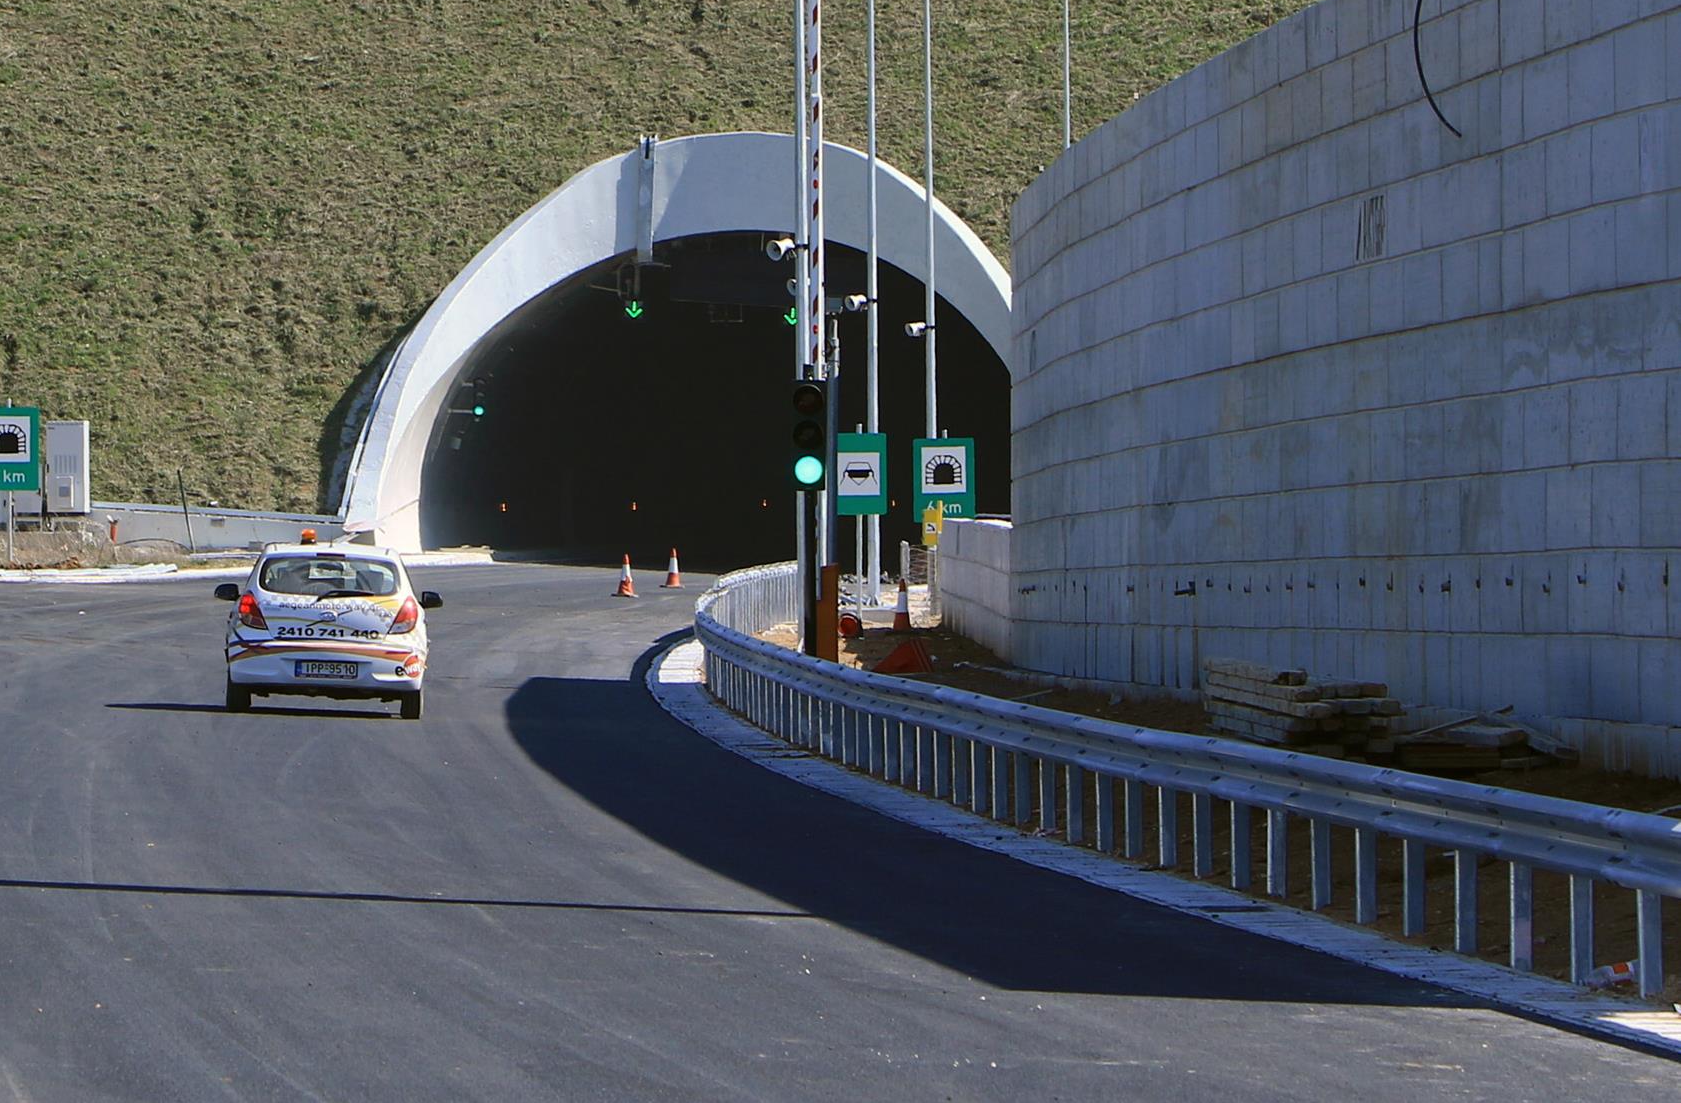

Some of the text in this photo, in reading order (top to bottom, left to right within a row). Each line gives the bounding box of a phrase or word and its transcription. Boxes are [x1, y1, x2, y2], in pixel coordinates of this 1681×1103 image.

[3, 469, 26, 483] km
[277, 626, 380, 640] 2410 741 440
